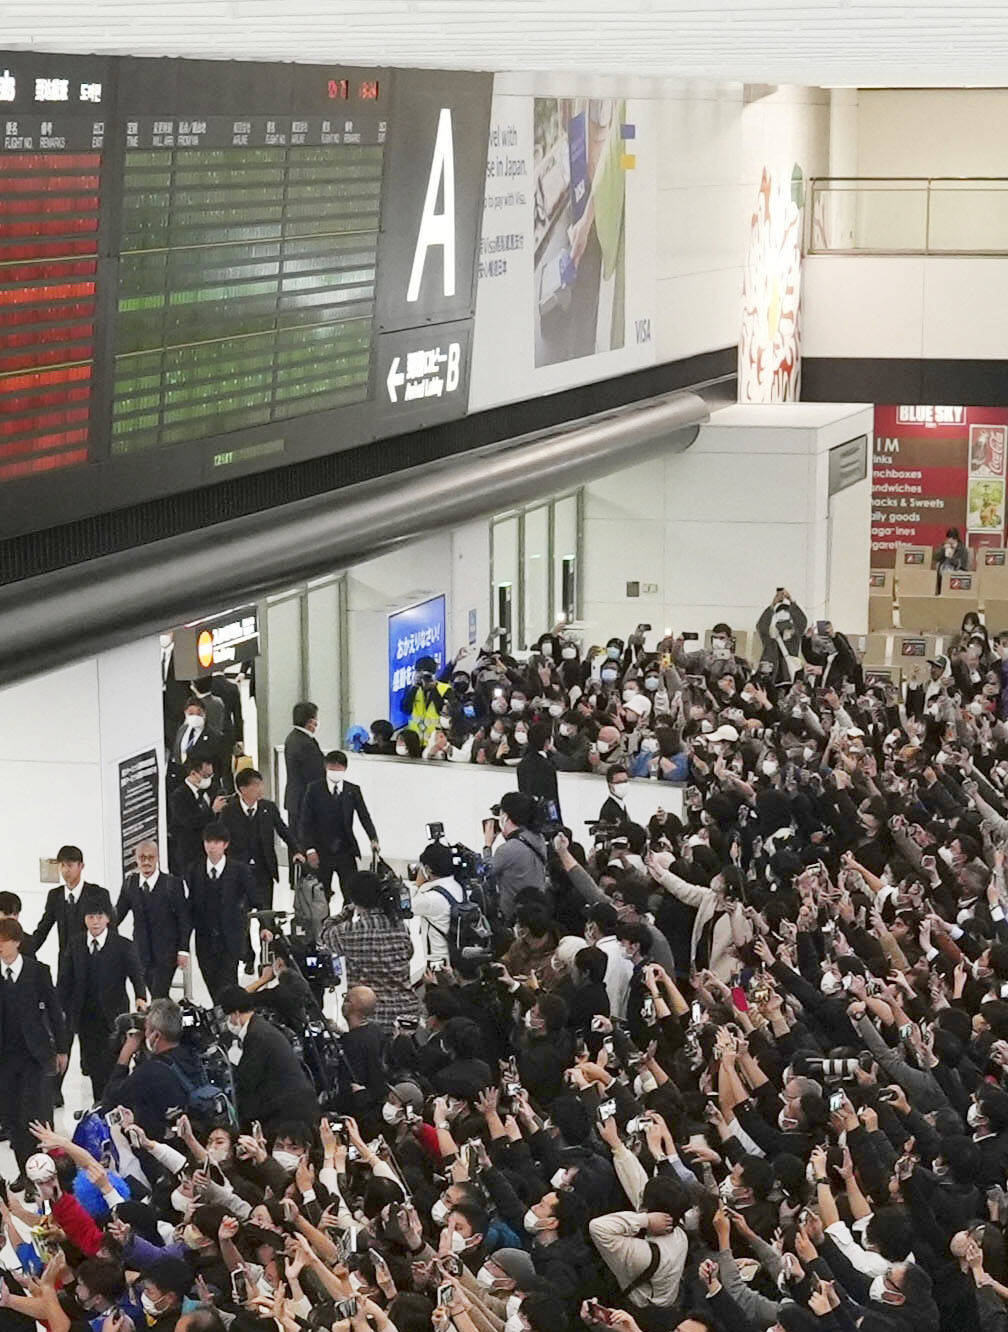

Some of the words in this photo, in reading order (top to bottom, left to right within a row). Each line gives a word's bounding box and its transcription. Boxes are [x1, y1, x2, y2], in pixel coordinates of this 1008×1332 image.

[406, 108, 456, 302] A
[445, 342, 460, 392] B
[899, 405, 934, 422] BLUE
